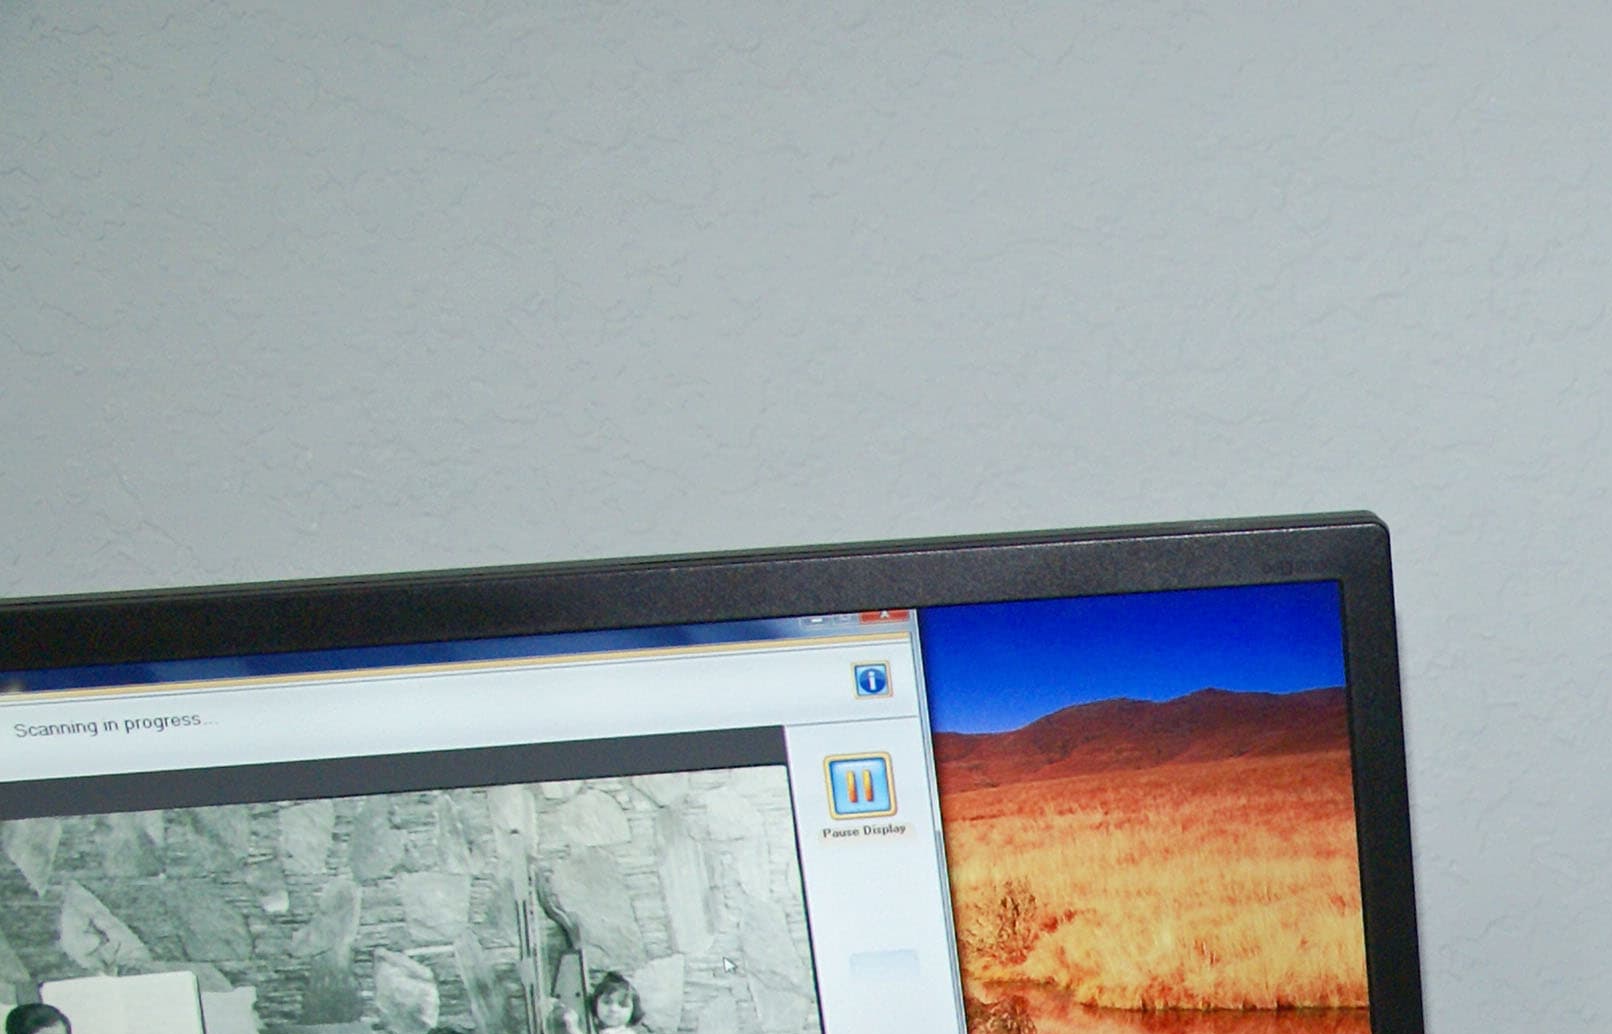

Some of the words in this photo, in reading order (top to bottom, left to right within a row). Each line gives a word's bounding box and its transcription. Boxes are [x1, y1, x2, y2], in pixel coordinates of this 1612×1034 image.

[14, 720, 99, 738] Scanning
[103, 719, 119, 732] in
[822, 828, 859, 838] Pause
[863, 823, 906, 835] Display
